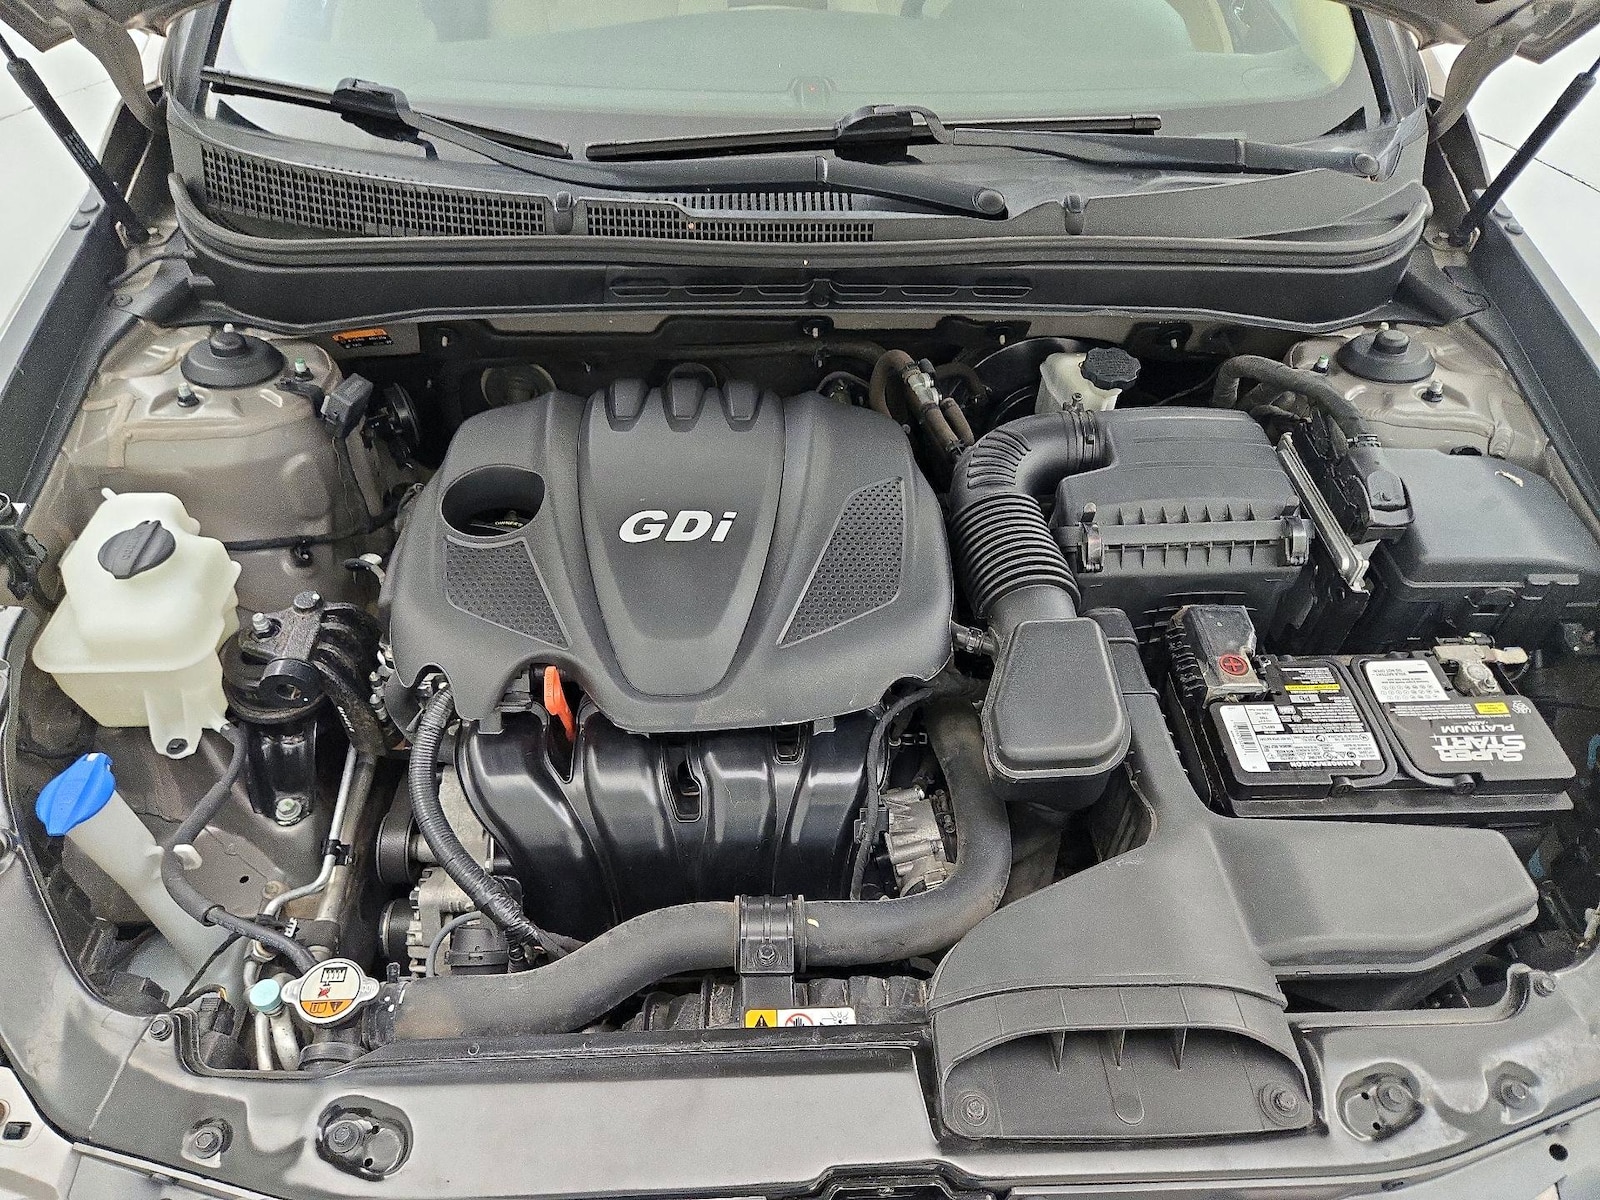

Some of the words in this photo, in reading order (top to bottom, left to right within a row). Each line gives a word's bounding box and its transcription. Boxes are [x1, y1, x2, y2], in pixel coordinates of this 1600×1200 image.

[619, 510, 738, 542] GDi
[1441, 724, 1515, 733] PLATINUM
[1433, 735, 1526, 751] START
[1439, 750, 1523, 762] SUPER
